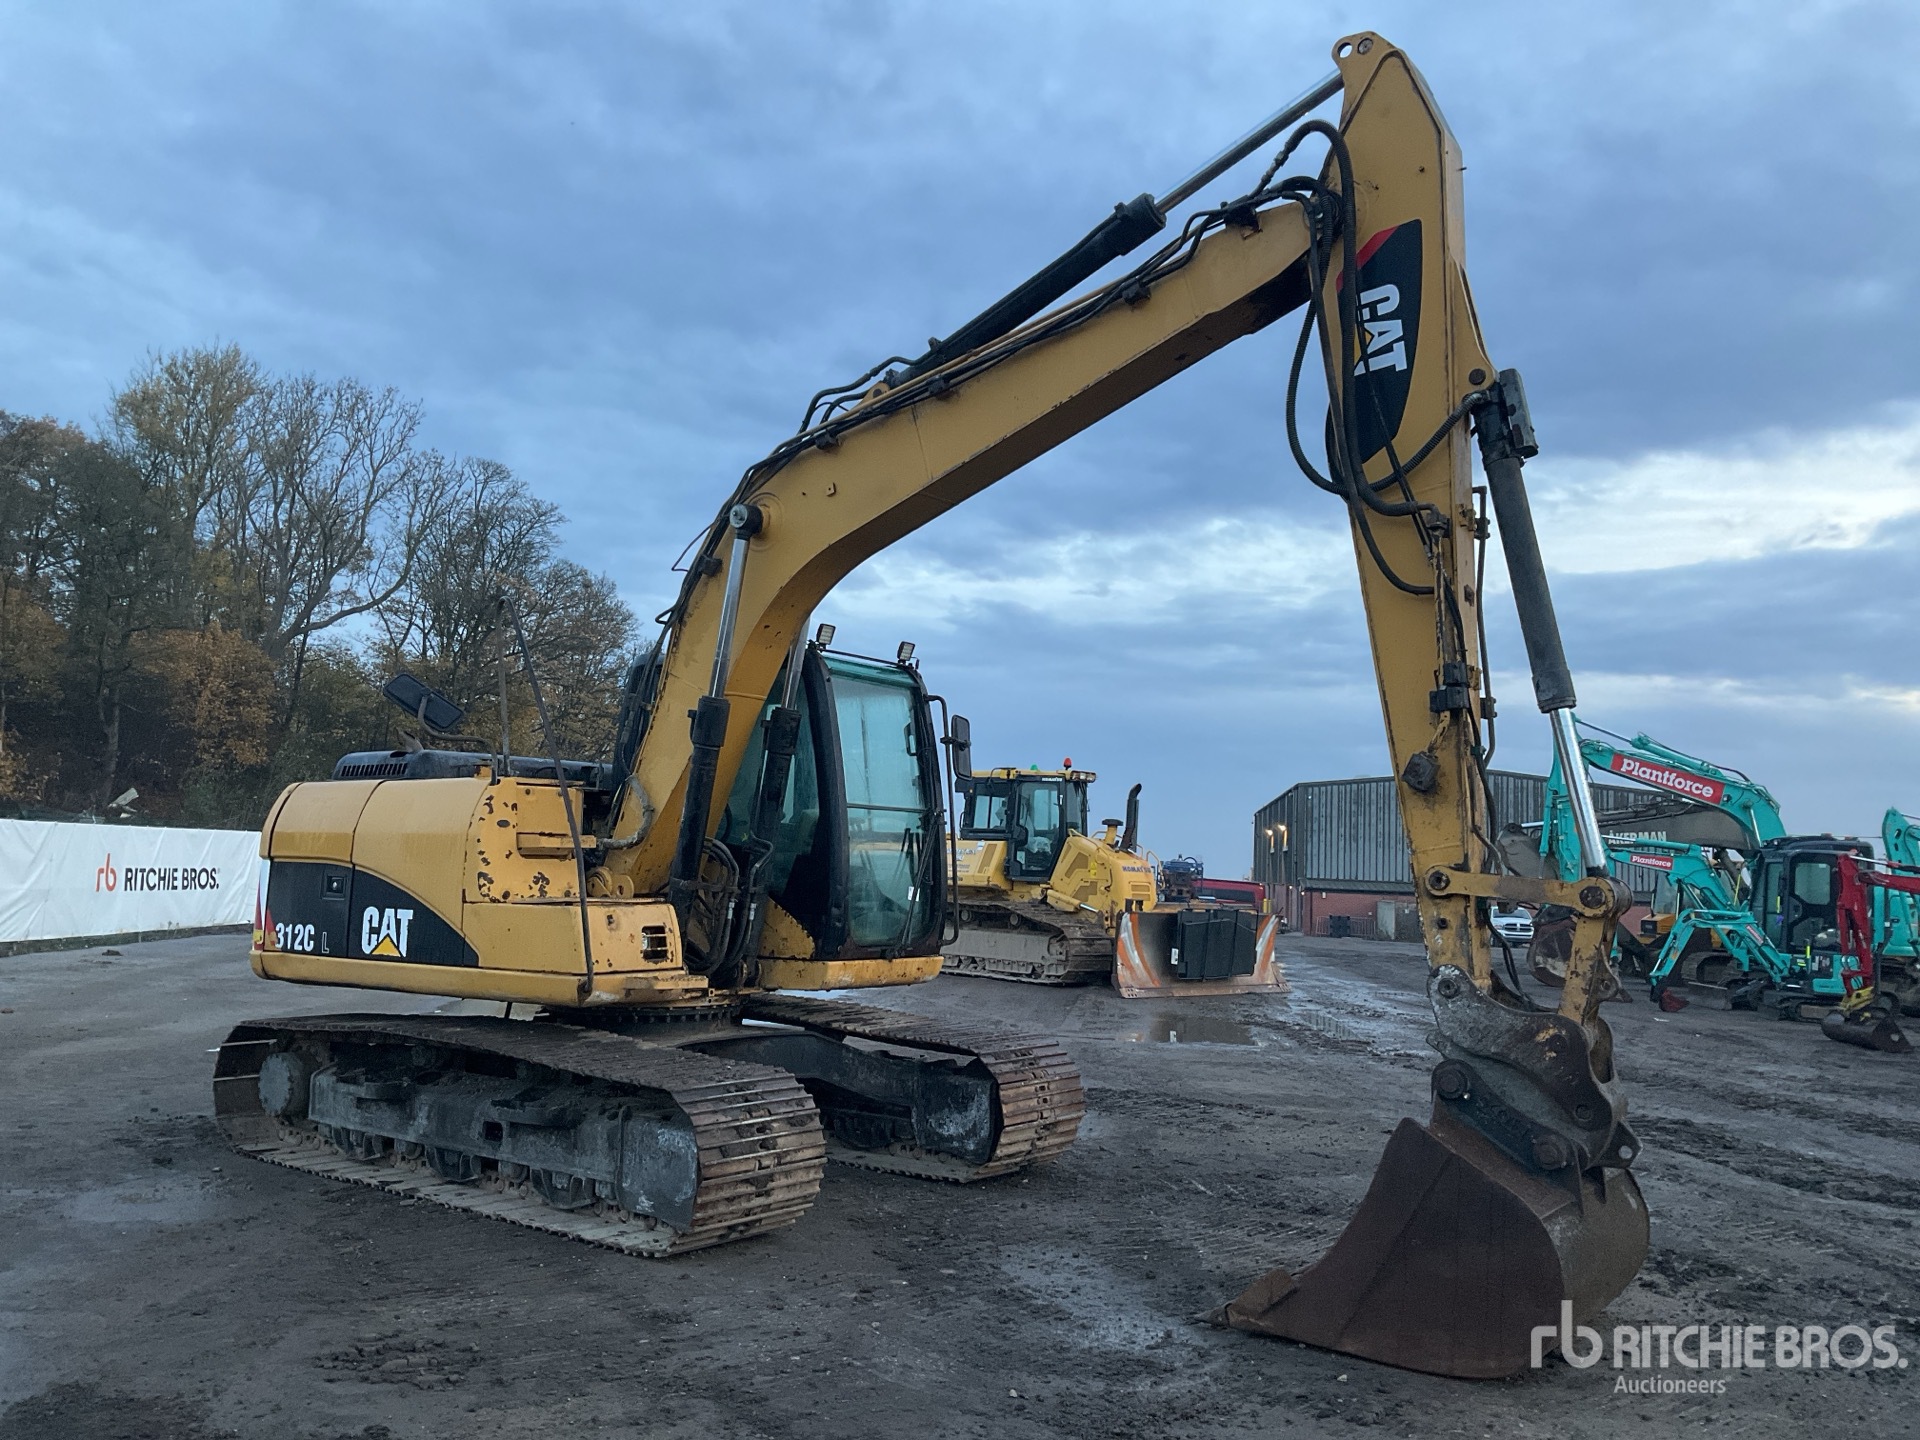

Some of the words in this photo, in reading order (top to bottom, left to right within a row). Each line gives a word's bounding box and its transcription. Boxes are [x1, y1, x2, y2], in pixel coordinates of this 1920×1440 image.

[1354, 284, 1407, 376] CAT
[1620, 758, 1714, 797] Plantforce
[96, 853, 117, 892] rb
[124, 867, 178, 891] RITCHIE
[181, 867, 219, 890] BROS.
[1631, 855, 1672, 867] Plantforce
[275, 922, 315, 951] 312C
[362, 906, 414, 957] CAT
